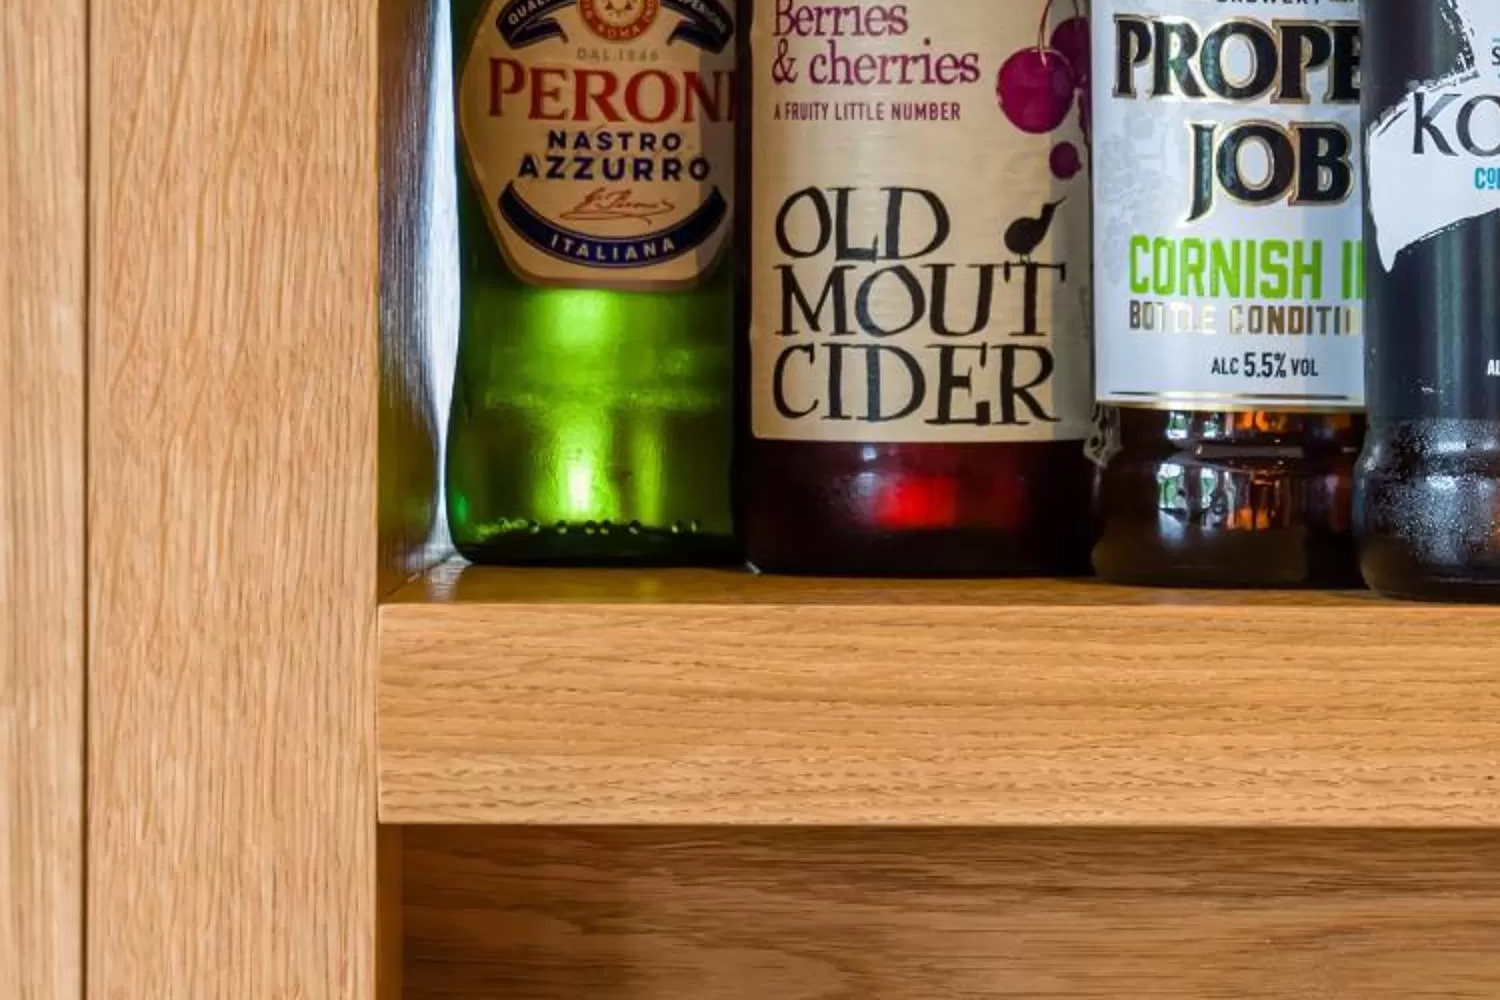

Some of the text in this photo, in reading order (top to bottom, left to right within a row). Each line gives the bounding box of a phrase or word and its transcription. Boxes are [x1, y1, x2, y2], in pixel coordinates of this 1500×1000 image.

[771, 37, 981, 86] & cherries
[1113, 13, 1361, 105] PROPE
[488, 55, 738, 125] PERONI
[773, 102, 961, 121] A FRUITY LITTLE NUMBER
[517, 153, 712, 183] AZZURRO
[547, 129, 683, 152] NASTRO
[1176, 118, 1355, 228] JOB
[549, 234, 677, 263] ITALIANA
[775, 185, 951, 263] OLD
[1128, 234, 1323, 300] CORNISH
[773, 260, 1067, 338] MOUT
[1128, 299, 1217, 335] BOTTLE
[773, 341, 1062, 426] CIDER
[1211, 351, 1319, 379] ALC 5.5% VOL
